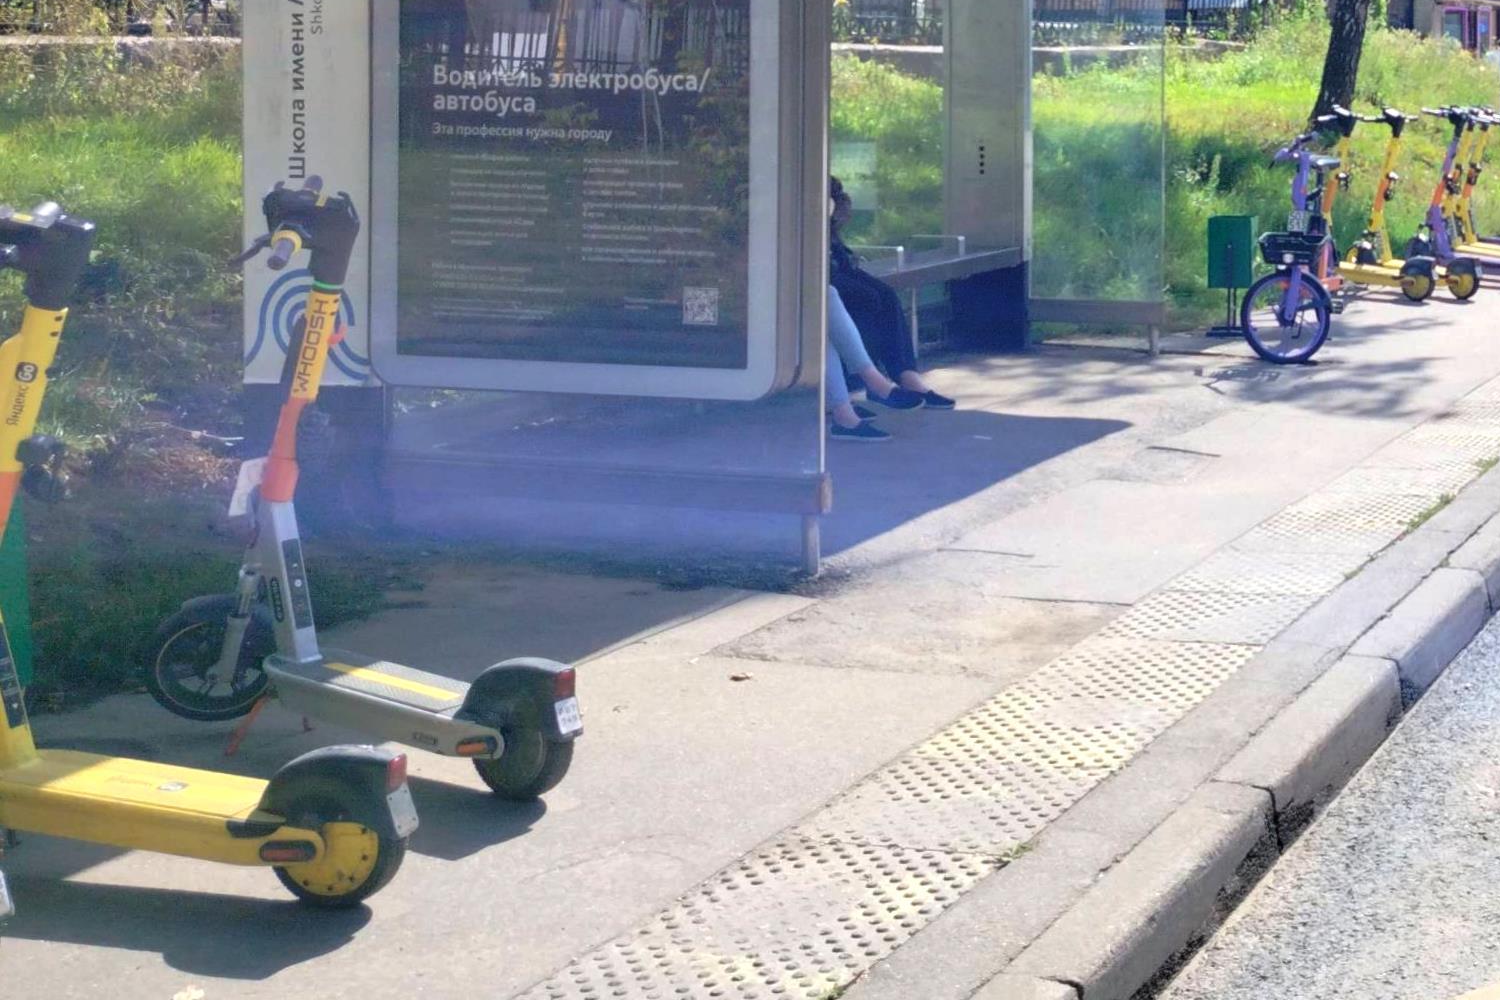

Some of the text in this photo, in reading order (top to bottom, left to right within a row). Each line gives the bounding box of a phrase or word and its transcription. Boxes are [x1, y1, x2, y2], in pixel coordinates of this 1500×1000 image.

[291, 12, 305, 90] имени
[433, 64, 543, 90] Водитель
[433, 90, 536, 117] автобуса
[287, 98, 306, 178] Школа
[432, 122, 613, 143] Эта профессия нужна городу
[293, 298, 329, 393] WHOOSH
[18, 364, 35, 381] Go
